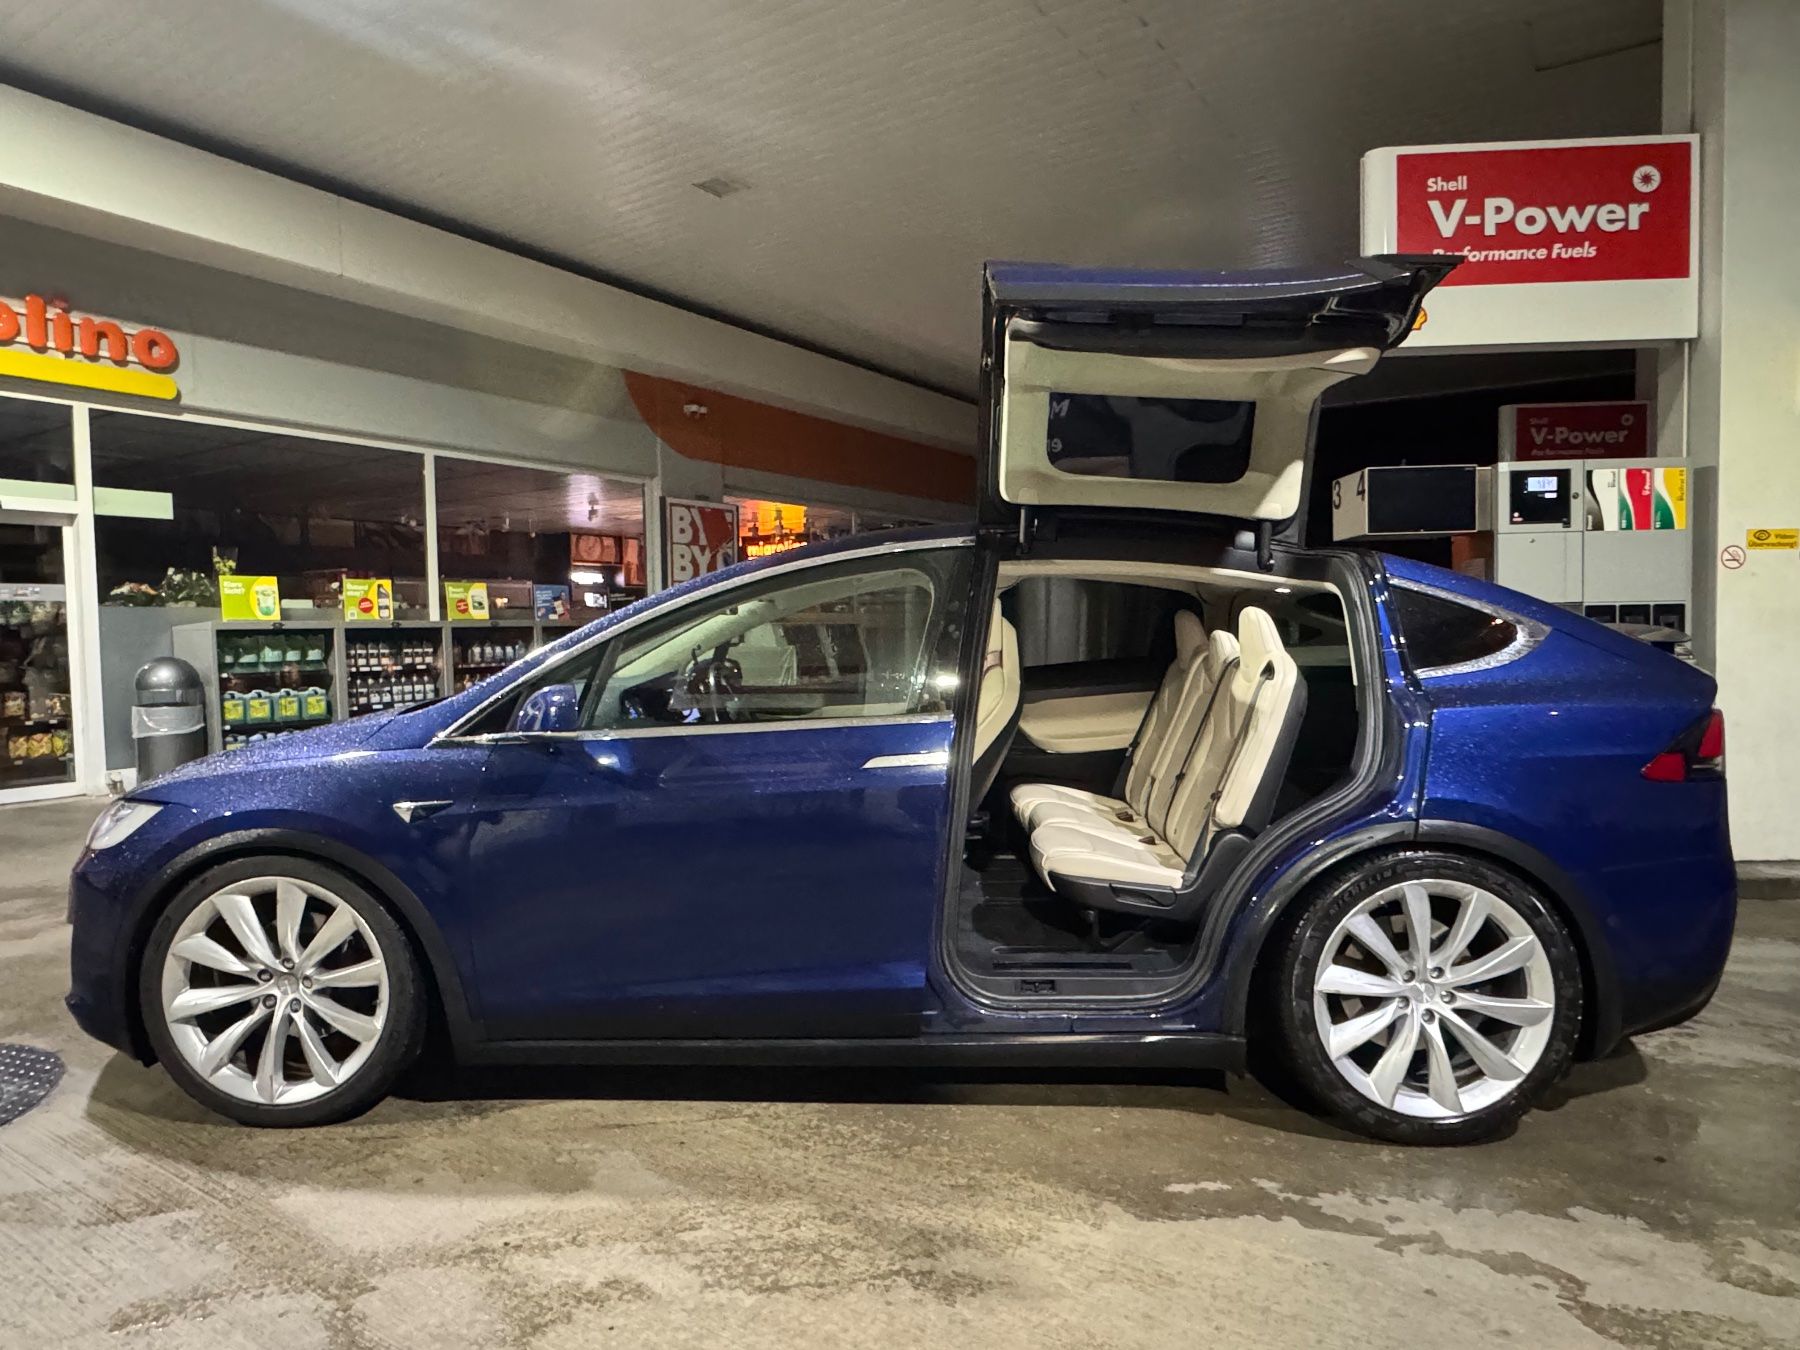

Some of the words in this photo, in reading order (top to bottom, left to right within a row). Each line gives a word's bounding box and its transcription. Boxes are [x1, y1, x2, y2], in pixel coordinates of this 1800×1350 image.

[1427, 175, 1467, 192] Shell
[1427, 197, 1650, 238] V-Power
[1432, 245, 1547, 262] formance
[1551, 241, 1598, 259] Fuels
[1530, 426, 1629, 445] V-Power
[1333, 480, 1341, 510] 3
[1356, 470, 1366, 502] 4
